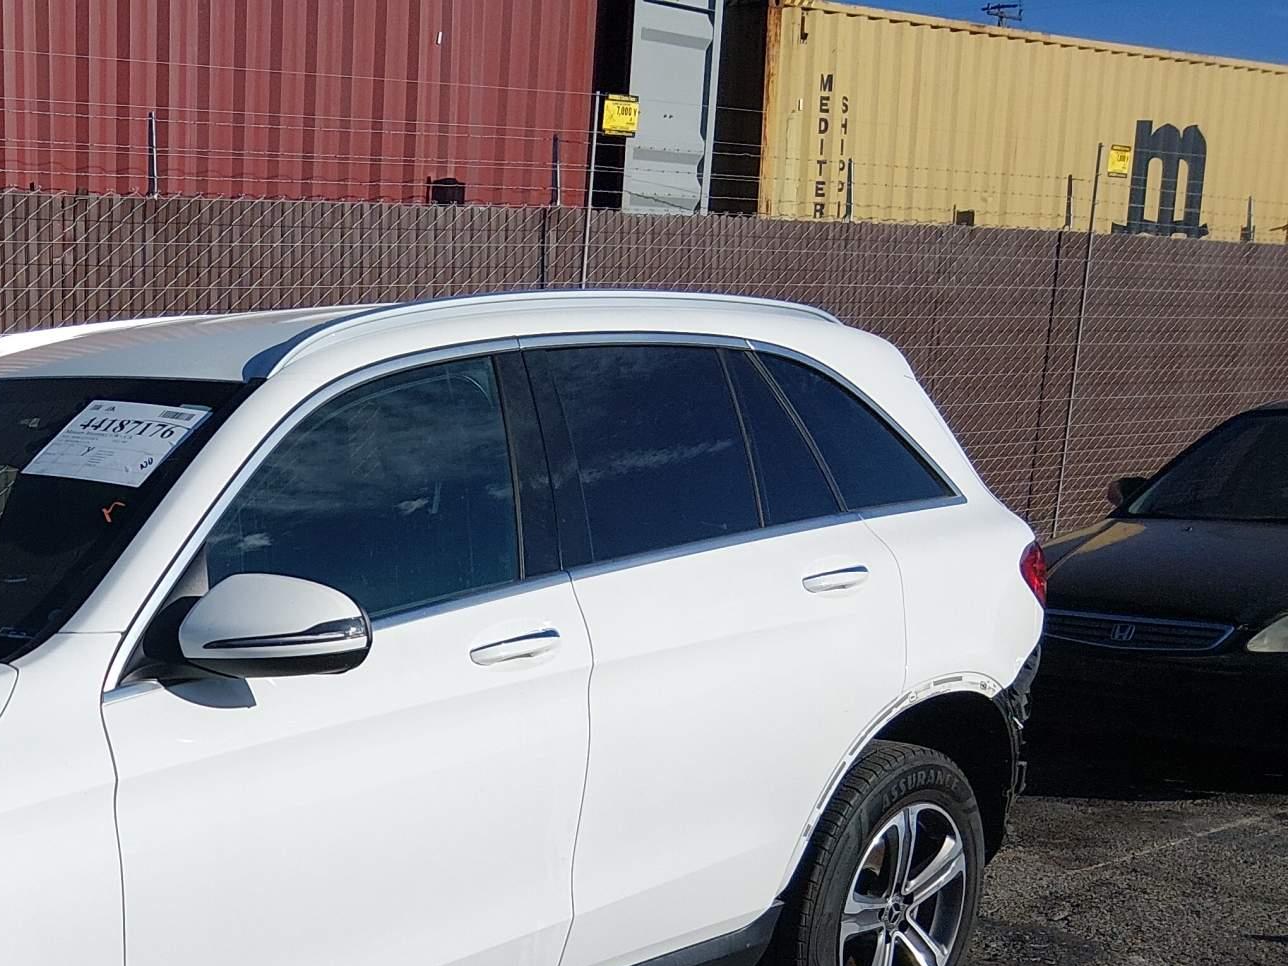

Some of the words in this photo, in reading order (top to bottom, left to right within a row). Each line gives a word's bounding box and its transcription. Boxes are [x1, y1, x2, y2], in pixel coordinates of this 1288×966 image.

[813, 73, 834, 219] MEDITER
[79, 416, 175, 439] 44187176
[881, 769, 961, 813] ASSURANCE
